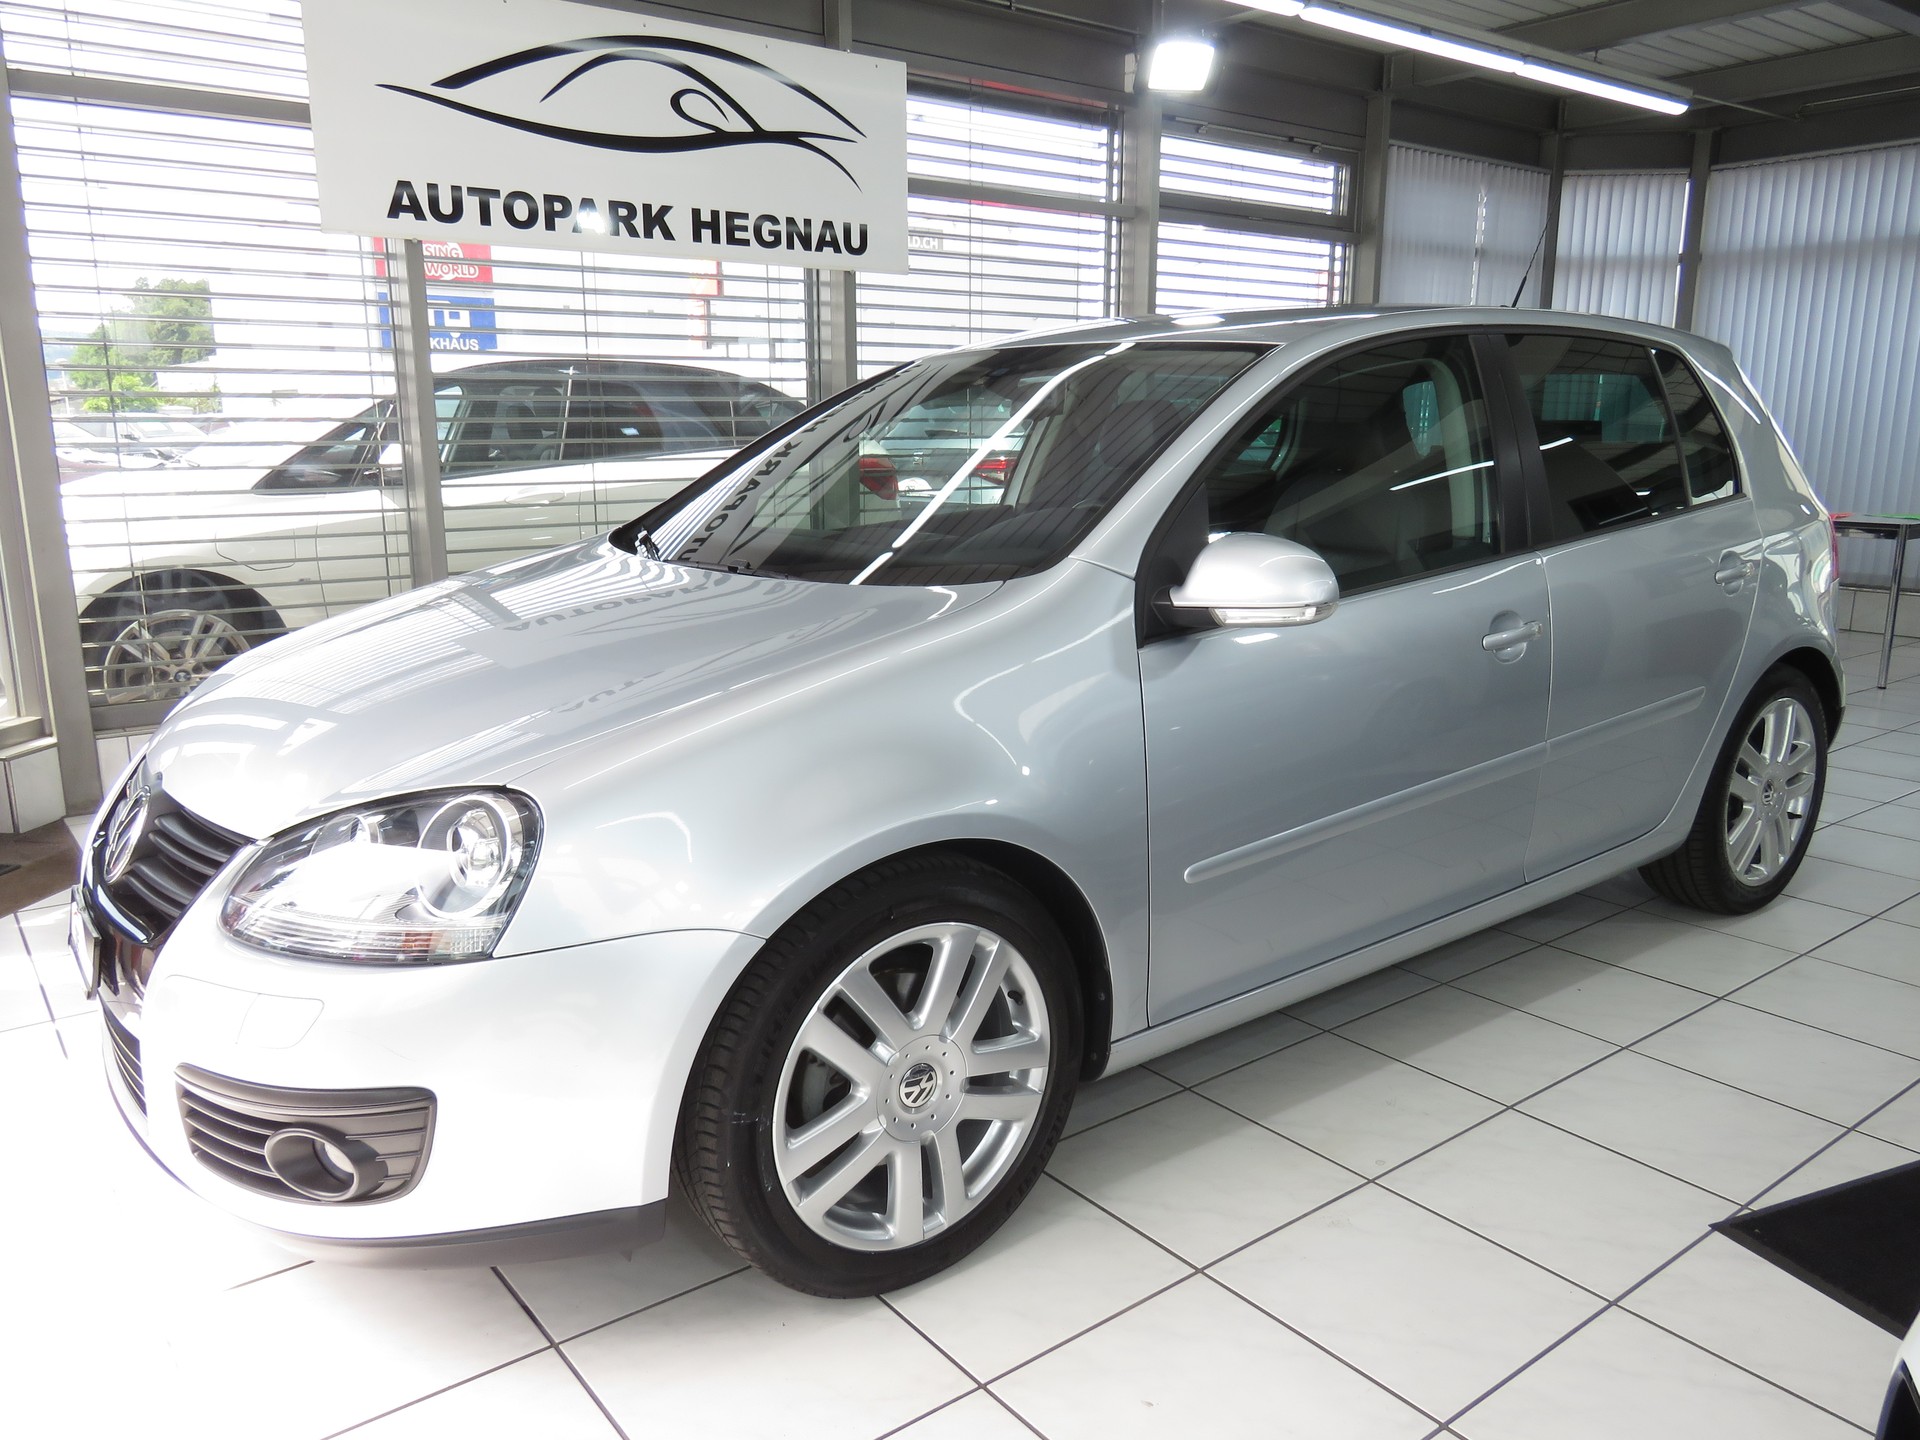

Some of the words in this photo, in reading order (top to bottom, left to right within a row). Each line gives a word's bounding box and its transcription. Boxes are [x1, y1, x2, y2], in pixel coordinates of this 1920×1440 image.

[387, 180, 675, 242] AUTOPARK
[691, 207, 868, 256] HEGNAU
[425, 262, 478, 277] WORLD
